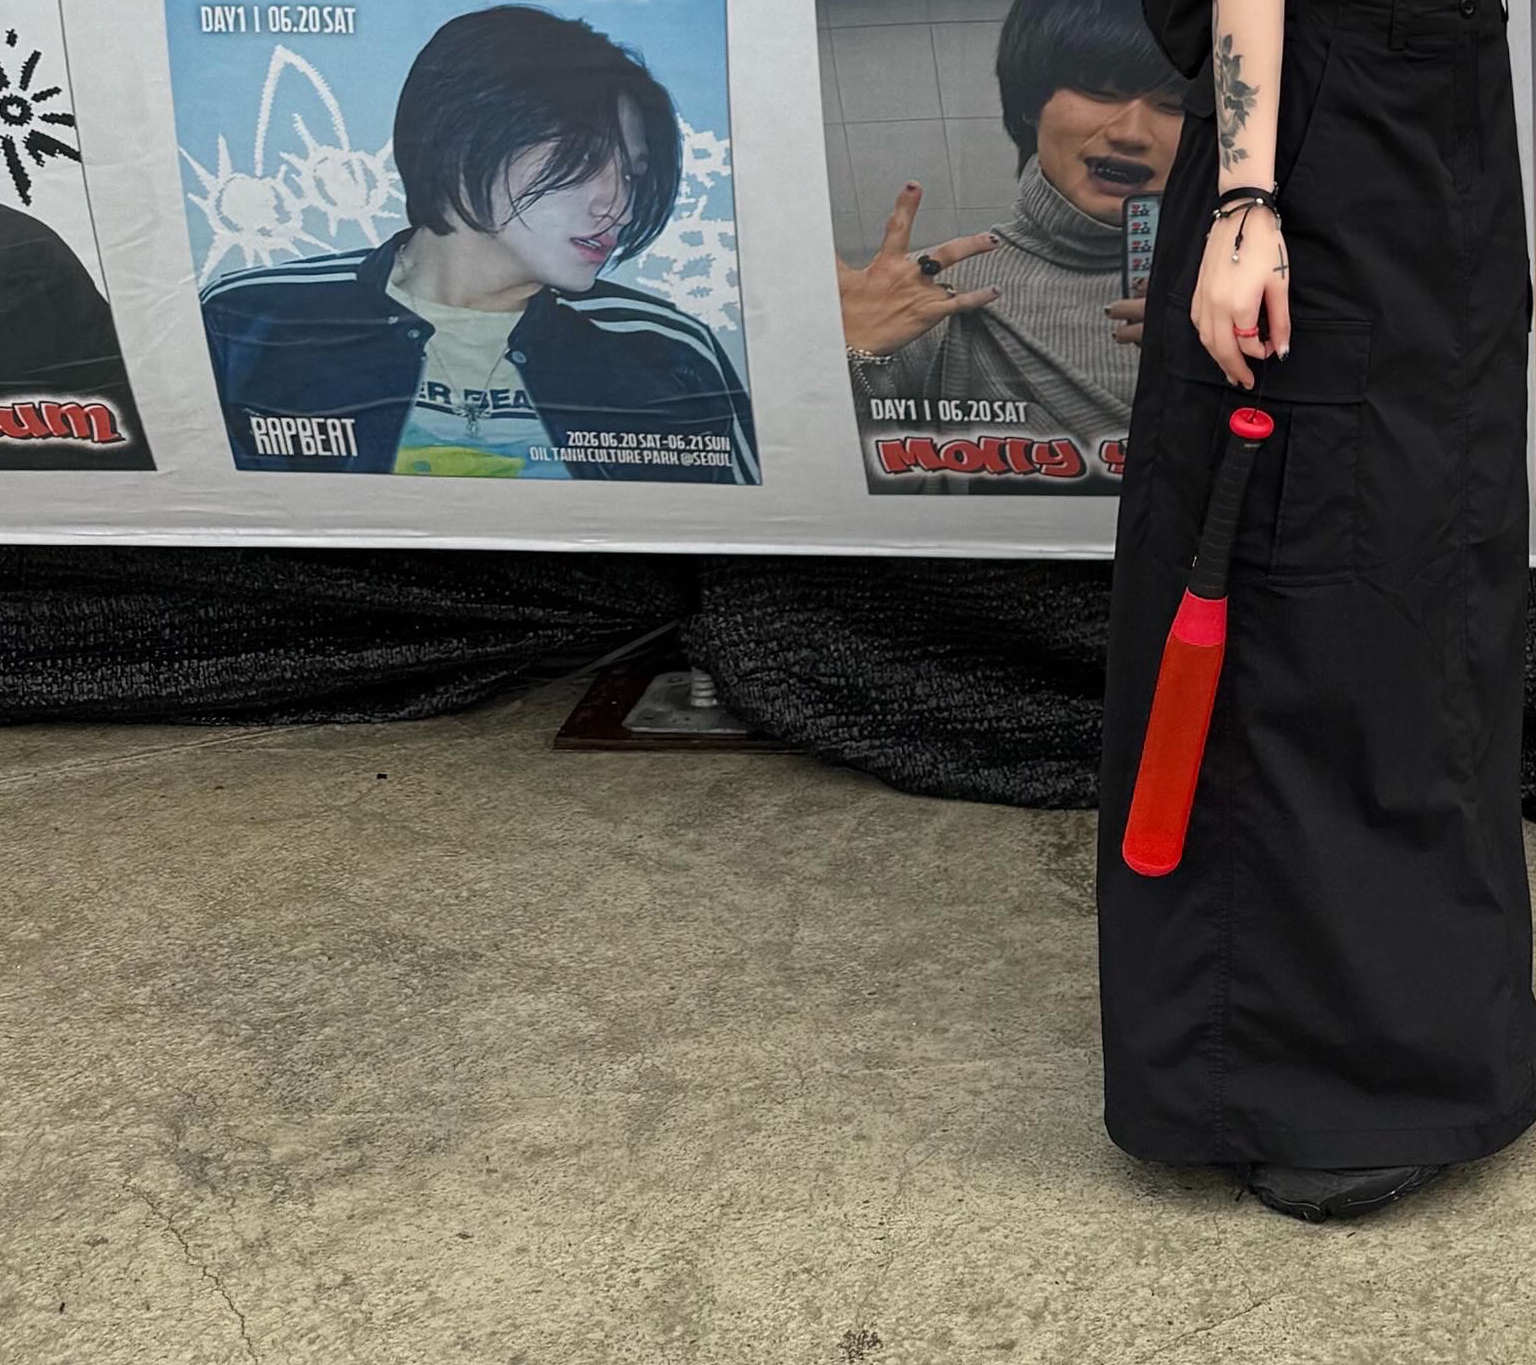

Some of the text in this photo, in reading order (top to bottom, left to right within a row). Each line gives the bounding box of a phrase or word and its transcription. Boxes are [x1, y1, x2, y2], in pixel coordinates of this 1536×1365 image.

[200, 6, 356, 35] DAY1 06.20 SAT
[870, 398, 1028, 423] DAY1 06.20 SAT
[250, 417, 358, 456] RAPBEAT
